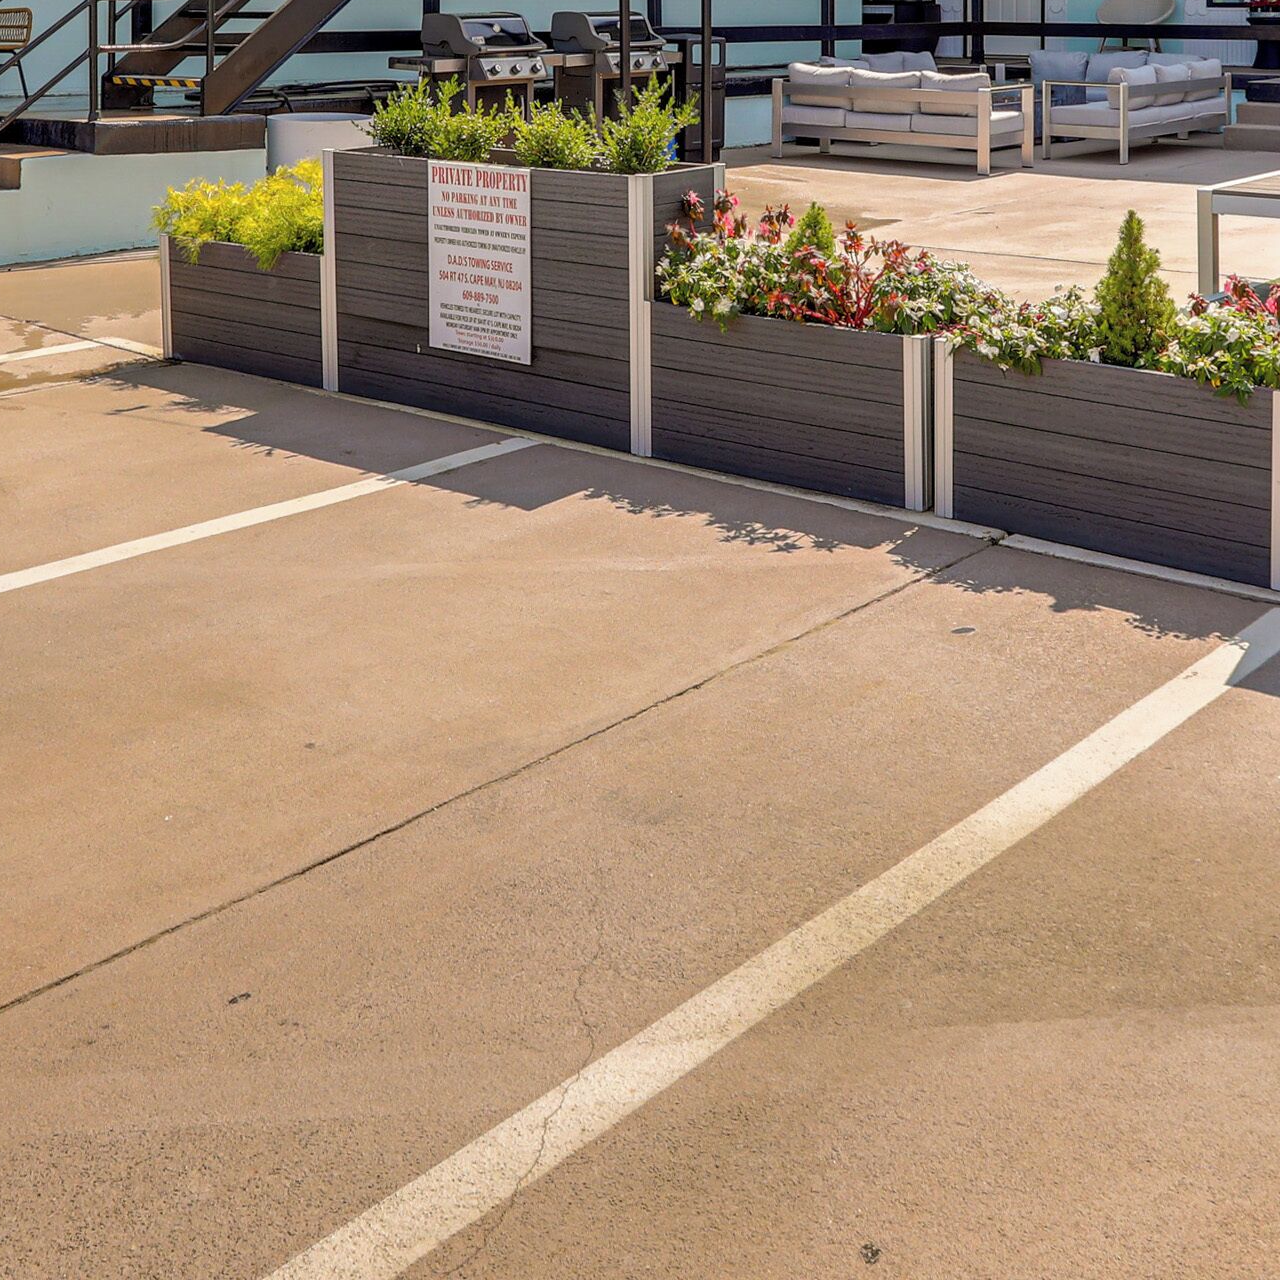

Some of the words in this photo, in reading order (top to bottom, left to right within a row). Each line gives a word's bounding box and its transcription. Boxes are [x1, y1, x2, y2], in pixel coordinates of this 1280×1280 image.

[432, 167, 472, 187] PRIVATE
[476, 170, 527, 192] PROPERTY
[441, 191, 450, 202] NO
[452, 192, 478, 205] PARKING
[480, 195, 487, 206] AT
[490, 196, 501, 207] ANY
[503, 197, 517, 209] TIME
[433, 206, 454, 218] UNLESS
[457, 208, 494, 223] AUTHORIZED
[496, 212, 503, 224] BY
[506, 213, 526, 226] OWNER
[469, 257, 490, 270] TOWING
[491, 260, 512, 273] SERVICE
[439, 270, 448, 281] 504
[450, 272, 456, 282] RT
[458, 273, 464, 283] 47
[470, 274, 483, 285] CAPE
[498, 278, 504, 288] NJ
[506, 279, 522, 291] 08204
